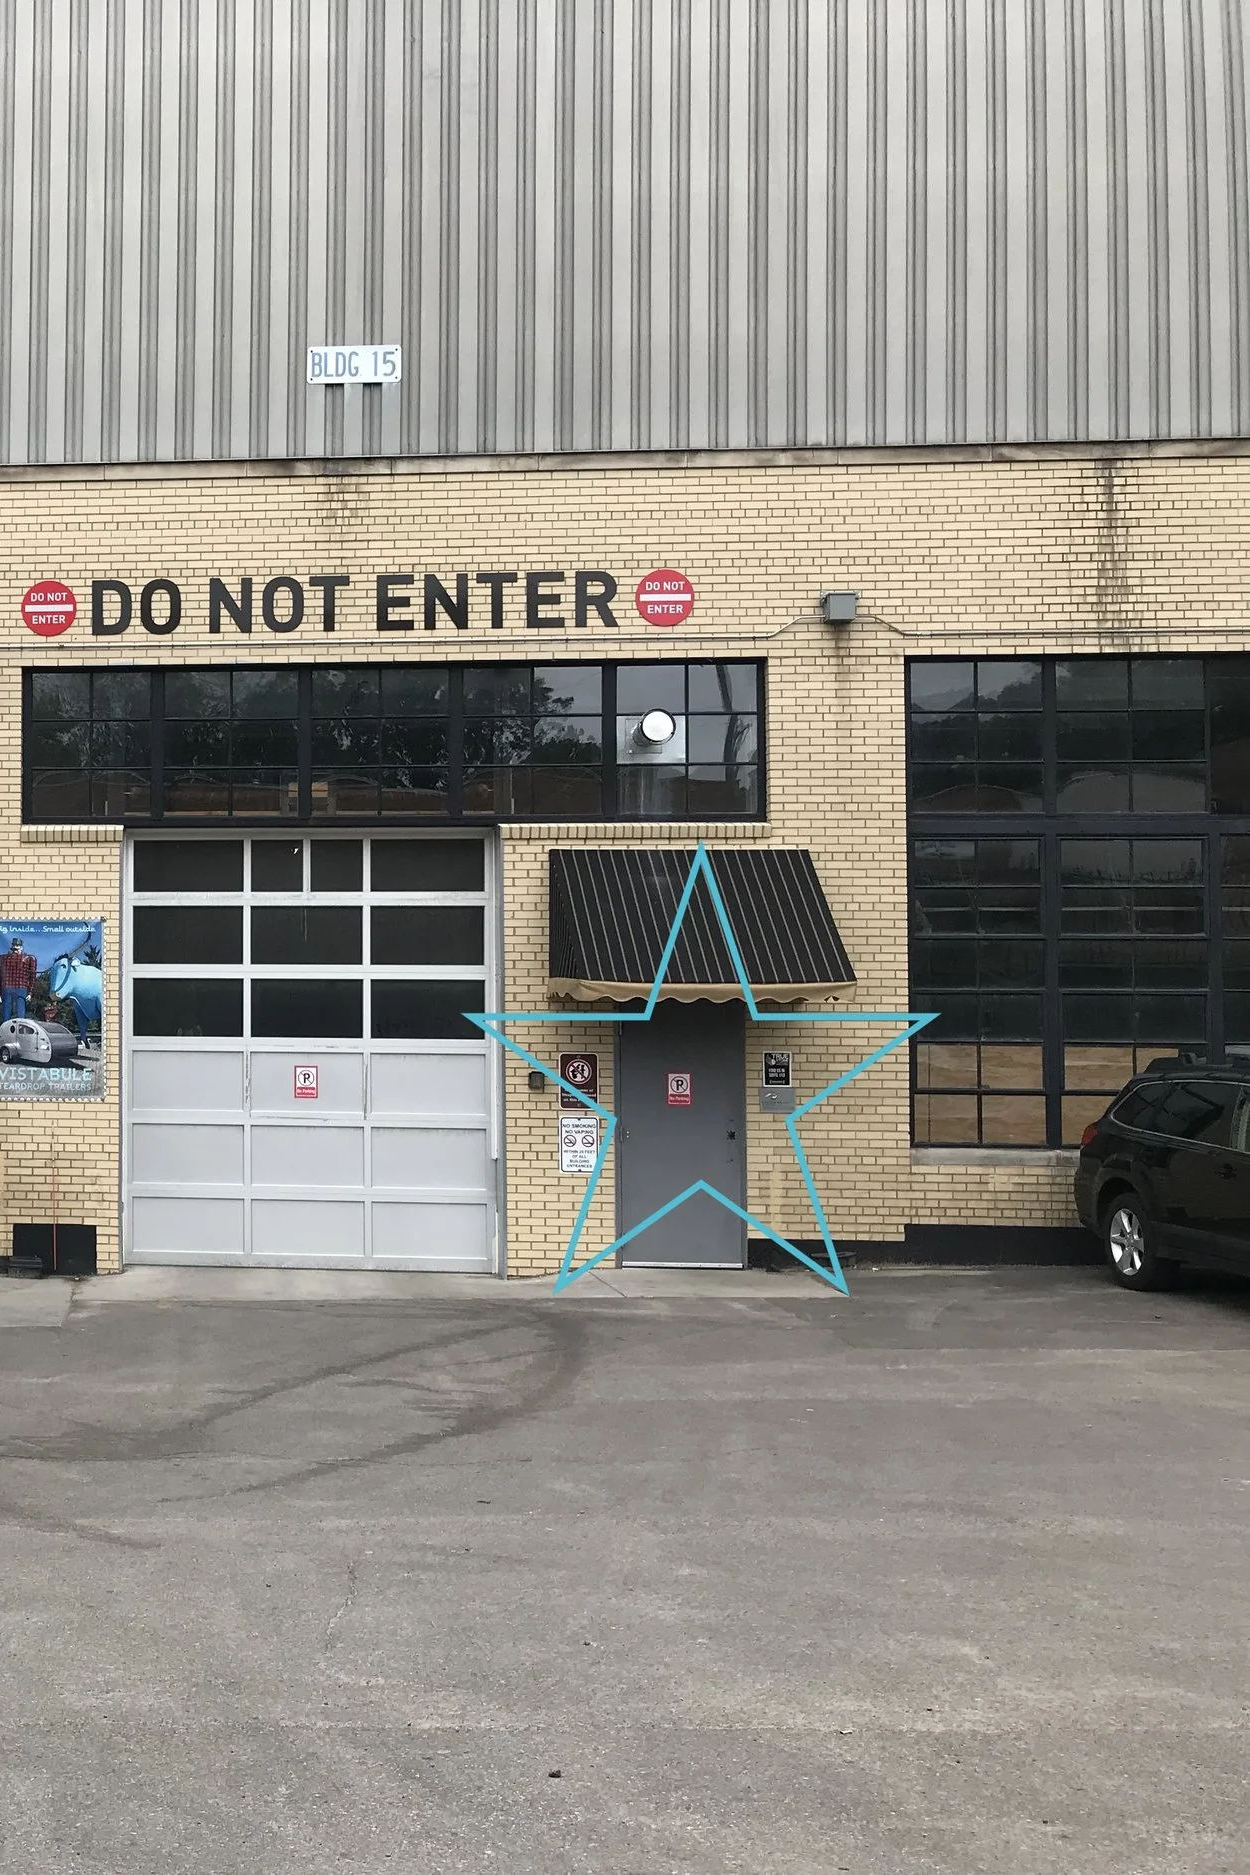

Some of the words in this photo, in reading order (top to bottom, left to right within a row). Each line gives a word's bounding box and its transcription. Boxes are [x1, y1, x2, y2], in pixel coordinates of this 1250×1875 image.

[311, 351, 359, 378] BLDG
[372, 351, 396, 377] 15
[645, 581, 660, 591] DO
[663, 581, 685, 591] NOT
[30, 592, 45, 602] DO
[47, 592, 68, 601] NOT
[92, 579, 182, 636] DO
[209, 575, 350, 633] NOT
[376, 571, 620, 631] ENTER
[647, 604, 684, 614] ENTER
[32, 615, 66, 624] ENTER
[42, 924, 64, 933] Small
[65, 924, 96, 933] outside
[49, 1083, 92, 1091] TRAILERS
